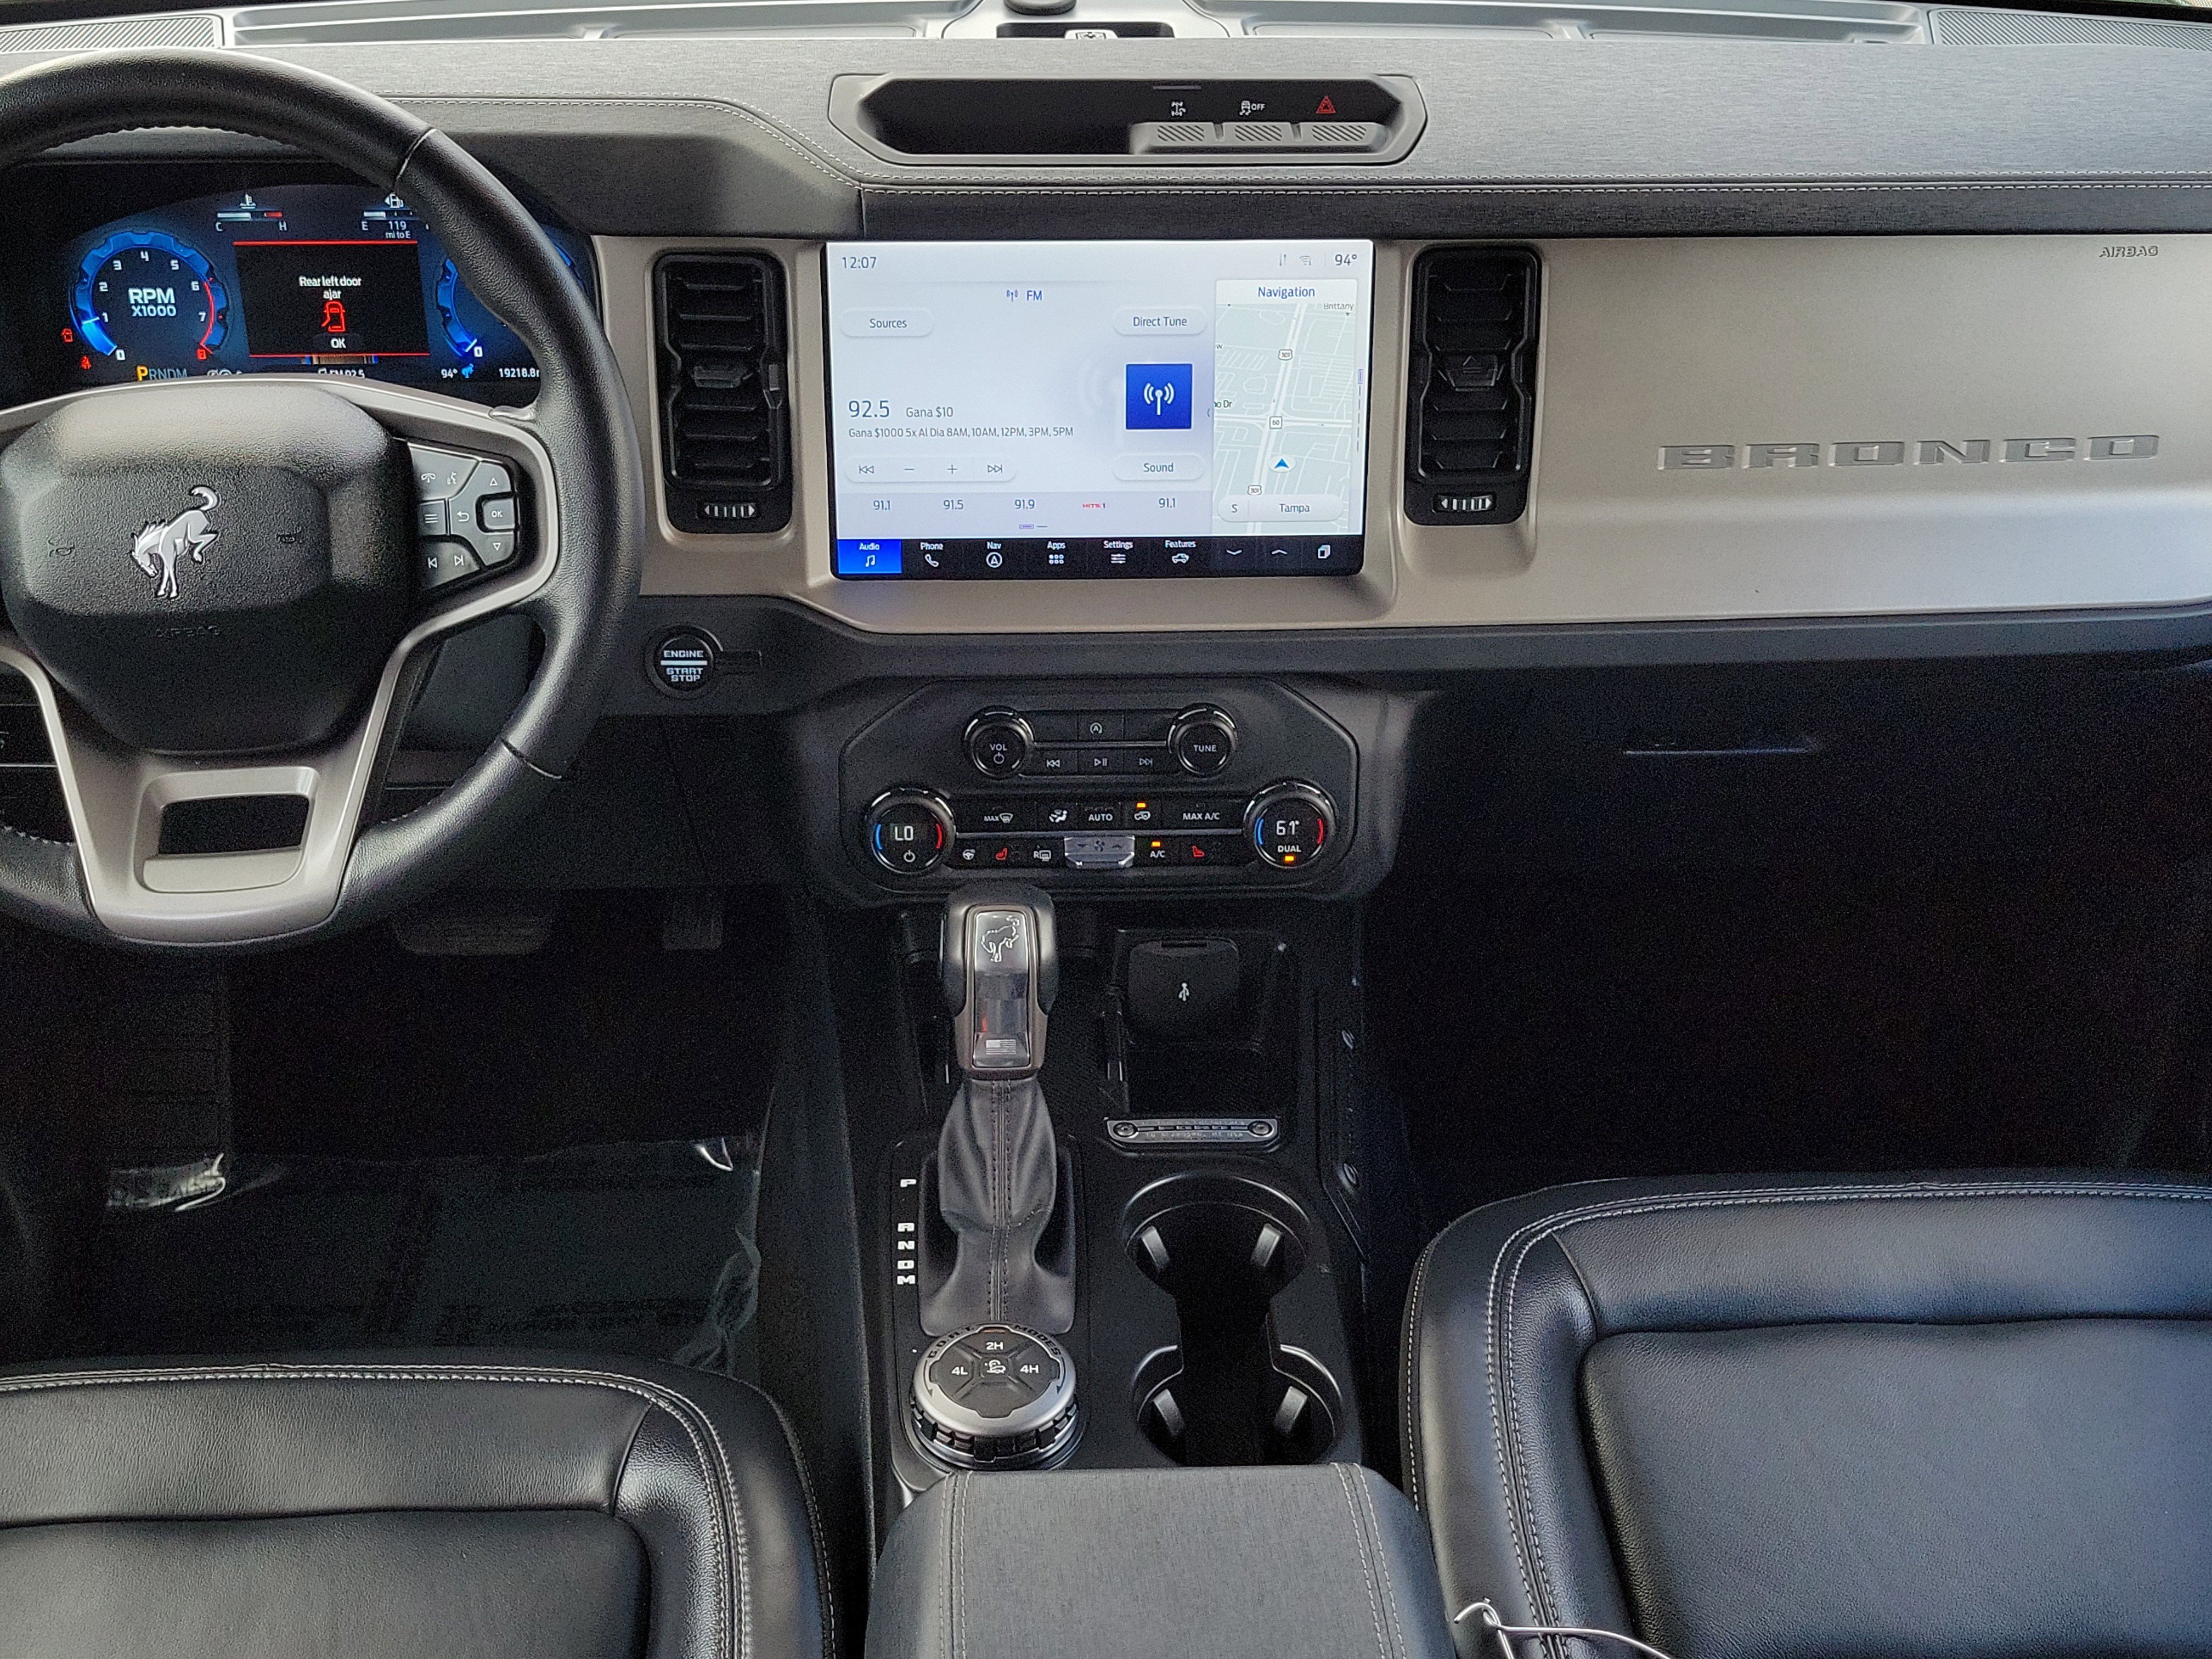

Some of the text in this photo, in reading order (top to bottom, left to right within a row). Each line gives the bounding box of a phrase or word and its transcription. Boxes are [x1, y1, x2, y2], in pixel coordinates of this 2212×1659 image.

[215, 222, 223, 232] C
[278, 221, 287, 232] H
[361, 221, 369, 231] E
[387, 221, 407, 231] 119
[385, 230, 411, 239] mi to E
[140, 251, 149, 261] 4
[2098, 245, 2159, 258] AIRBAG
[112, 259, 122, 270] 3
[170, 259, 179, 270] 5
[842, 256, 877, 269] 12:07
[1334, 253, 1358, 266] 94°
[191, 280, 200, 291] 6
[298, 275, 362, 286] Rear left door
[99, 281, 109, 292] 2
[128, 287, 176, 304] RPM
[323, 289, 342, 301] ajar
[1026, 290, 1043, 301] FM
[1257, 286, 1316, 300] Navigation
[132, 305, 177, 317] X1000
[101, 312, 109, 323] 1
[198, 312, 206, 322] 7
[1133, 317, 1187, 326] Direct Tune
[869, 318, 907, 329] Sources
[330, 337, 347, 348] OK
[115, 349, 126, 360] 0
[1223, 399, 1232, 408] Dr
[849, 400, 953, 418] 92.5 Gana $10
[849, 428, 872, 438] Gana
[874, 427, 904, 438] $1000
[905, 428, 917, 437] 5x
[946, 427, 970, 438] 8AM,
[972, 427, 1000, 438] 10AM,
[1001, 427, 1027, 437] 12PM,
[1028, 427, 1052, 437] 3PM,
[1053, 427, 1074, 437] 5PM
[1657, 435, 2160, 470] BRONCO
[1143, 462, 1174, 472] Sound
[873, 500, 891, 511] 91.1
[943, 499, 964, 510] 91.5
[1014, 499, 1035, 509] 91.9
[1159, 498, 1176, 508] 91.1
[1231, 504, 1238, 513] S
[1279, 504, 1310, 514] Tampa
[859, 542, 880, 550] Audio
[920, 542, 944, 550] Phone
[987, 541, 1002, 550] Nav
[1047, 540, 1066, 550] Apps
[1103, 540, 1133, 550] Settings
[1165, 540, 1197, 548] Features
[663, 650, 704, 658] ENGINE
[670, 674, 701, 682] STOP
[1193, 744, 1217, 753] TUNE
[1088, 814, 1113, 822] AUTO
[1182, 812, 1220, 821] MAX A/C
[894, 826, 914, 842] LO
[1149, 850, 1166, 859] A/C
[900, 1178, 917, 1188] P
[898, 1240, 915, 1250] N
[896, 1275, 916, 1285] M
[1014, 1324, 1062, 1356] MODES
[986, 1341, 1004, 1350] 2H
[951, 1366, 969, 1375] 4L
[1020, 1364, 1039, 1374] 4H
